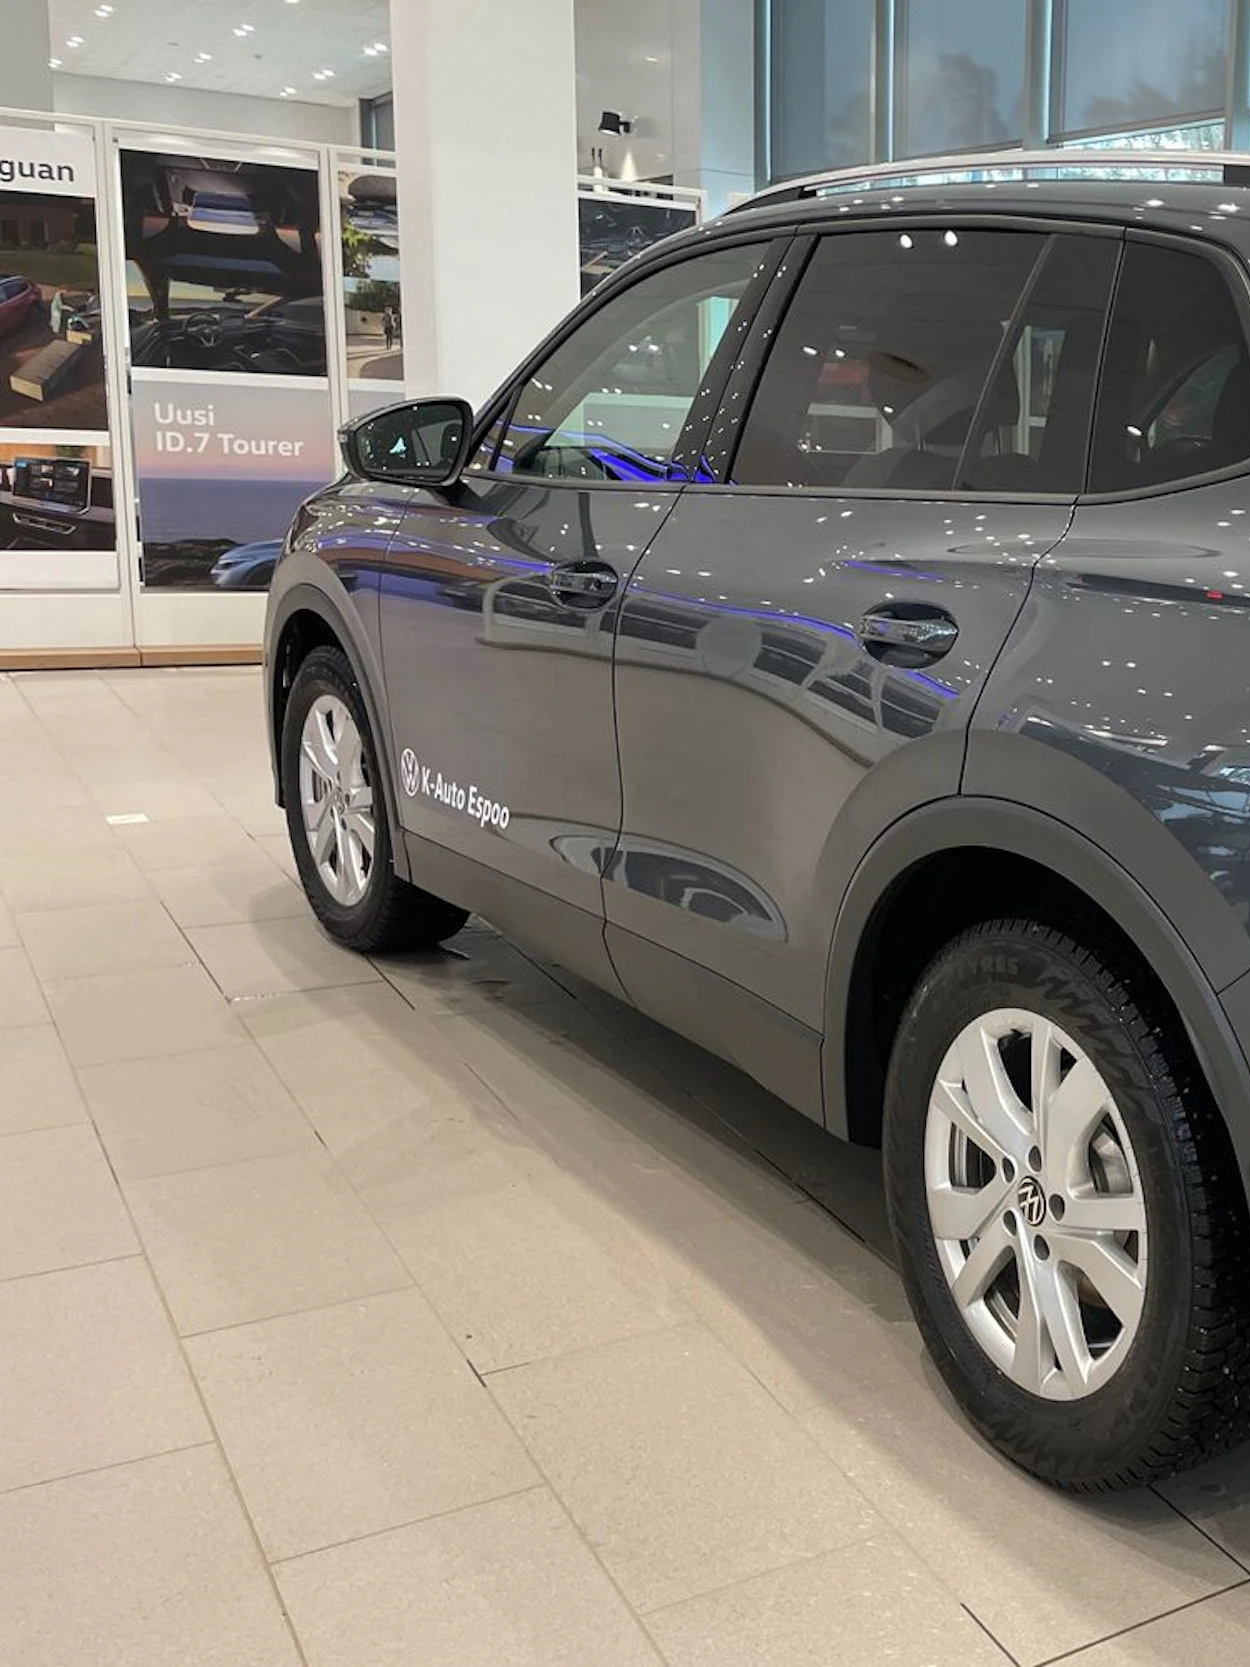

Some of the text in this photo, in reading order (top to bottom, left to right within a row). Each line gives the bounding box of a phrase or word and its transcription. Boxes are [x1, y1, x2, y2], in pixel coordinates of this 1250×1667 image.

[0, 160, 75, 182] guan
[154, 402, 215, 426] Uusi
[156, 431, 304, 456] ID.7 Tourer
[421, 766, 466, 810] K-Auto
[467, 784, 510, 829] Espoo
